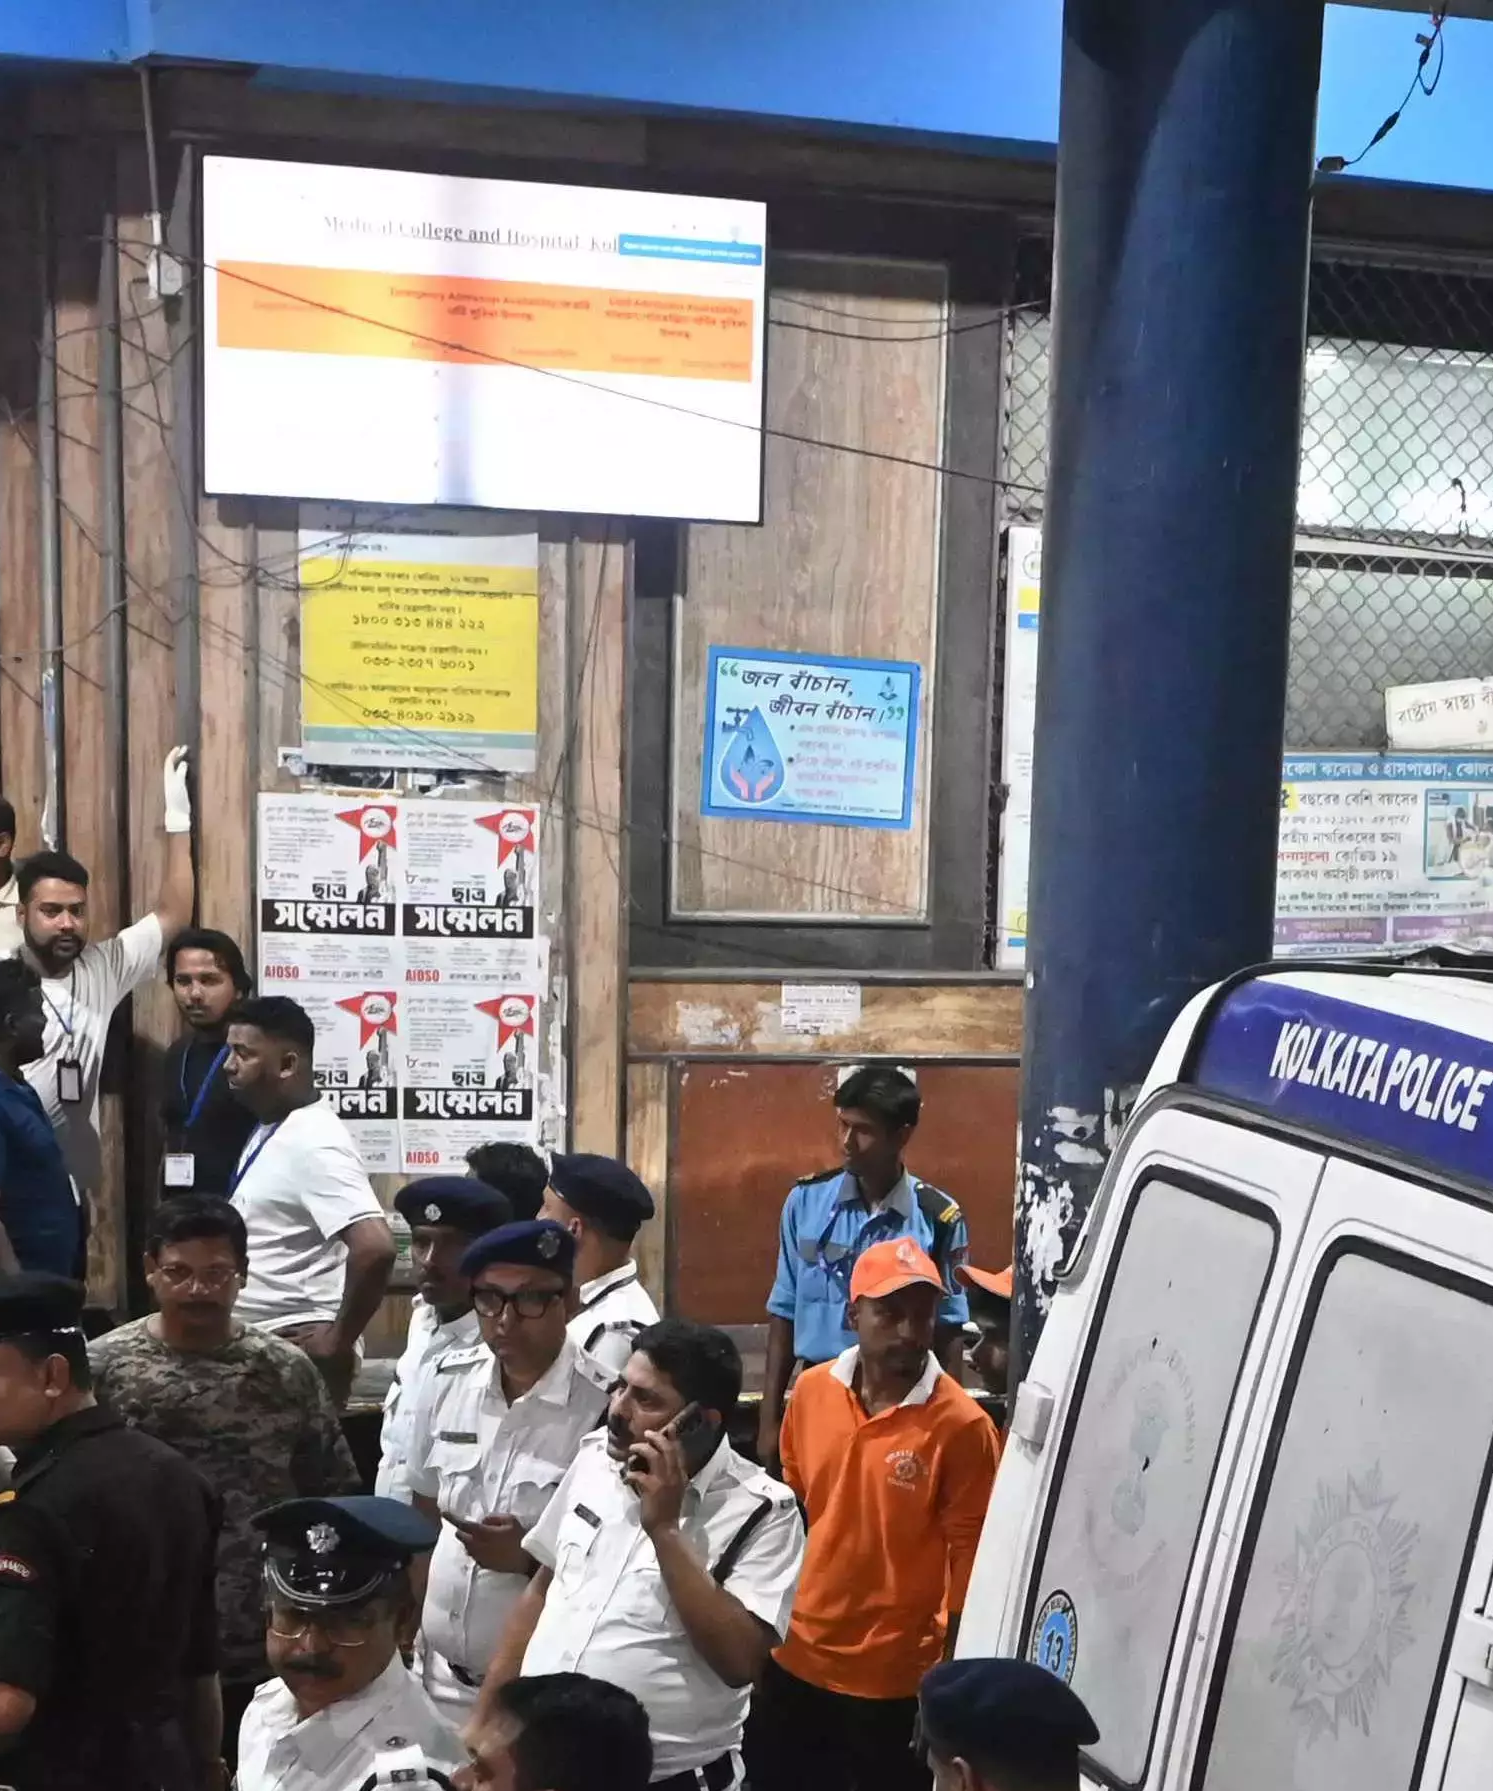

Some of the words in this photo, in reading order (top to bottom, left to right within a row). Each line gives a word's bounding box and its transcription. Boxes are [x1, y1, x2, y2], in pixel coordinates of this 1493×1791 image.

[399, 221, 462, 243] College
[469, 227, 500, 245] and
[352, 614, 389, 627] ১৮০০
[426, 617, 454, 629] ৪৪৪
[459, 618, 486, 632] ২২২
[789, 670, 855, 698] বাঁচান,
[768, 693, 822, 718] জীবন
[1321, 763, 1363, 778] কলেজ
[1298, 791, 1341, 806] বছরের
[1344, 788, 1374, 807] বেশি
[1376, 792, 1420, 807] বয়সের
[1312, 827, 1377, 845] নাগরিকদের
[1335, 846, 1378, 864] কোভিড
[1381, 851, 1398, 863] ১৯
[312, 883, 347, 900] ছাত্র
[451, 887, 486, 904] ছাত্র
[274, 900, 386, 932] সম্মেলন
[414, 906, 525, 936] সম্মেলন
[264, 965, 300, 980] AIDSO
[405, 969, 440, 982] AIDSO
[1268, 1018, 1390, 1104] KOLKATA
[451, 1070, 486, 1086] ছাত্র
[414, 1089, 524, 1118] সম্মেলন
[405, 1151, 440, 1164] AIDSO
[1045, 1629, 1064, 1673] 13
